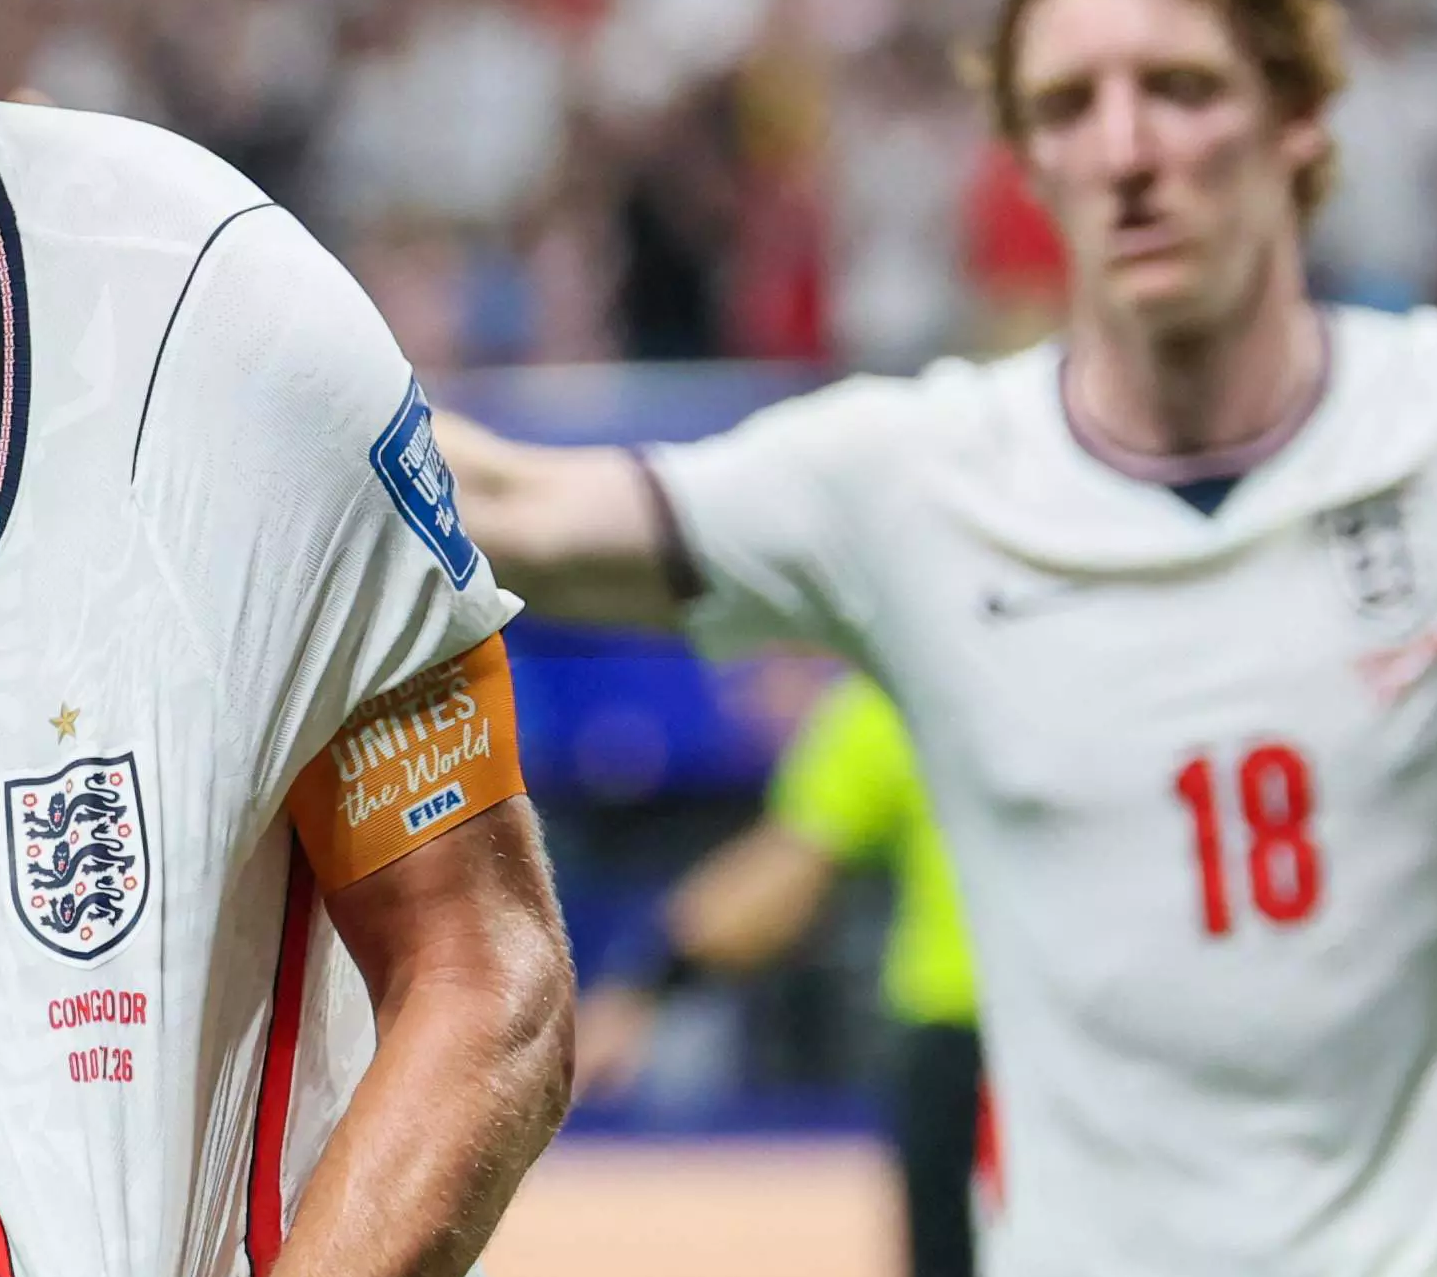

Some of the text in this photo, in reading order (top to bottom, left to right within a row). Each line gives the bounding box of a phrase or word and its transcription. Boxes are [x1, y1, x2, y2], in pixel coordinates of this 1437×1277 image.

[331, 677, 477, 783] UNITES
[338, 718, 491, 828] the World
[408, 790, 462, 829] FIFA
[1173, 741, 1323, 937] 18
[48, 989, 147, 1029] CONGO DR
